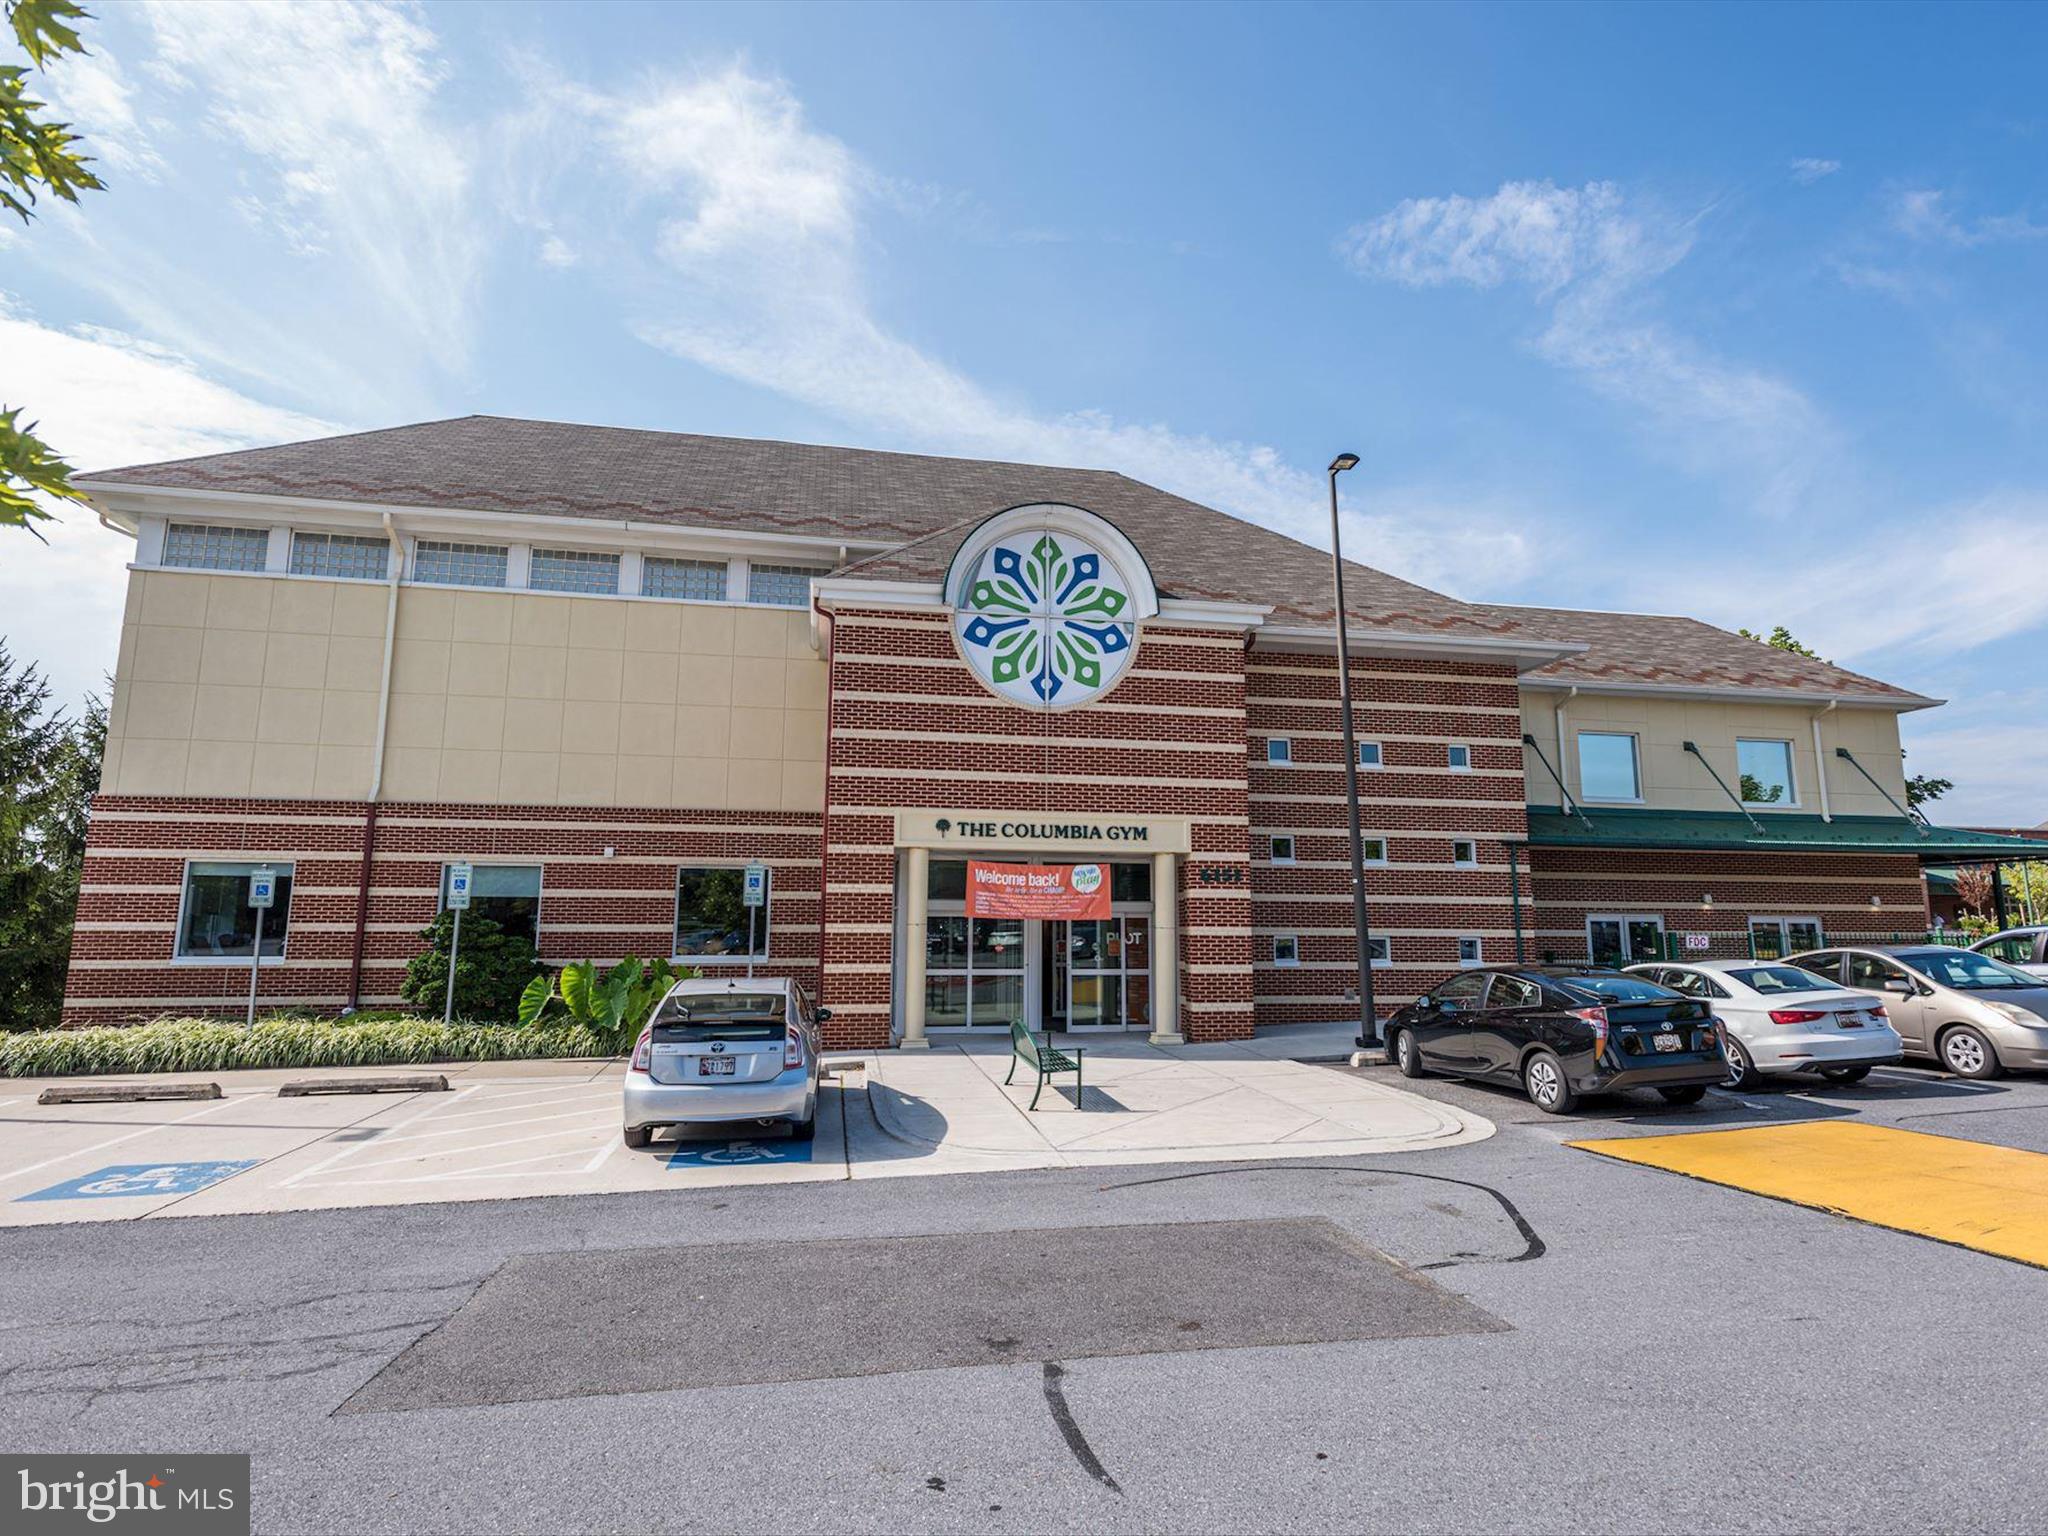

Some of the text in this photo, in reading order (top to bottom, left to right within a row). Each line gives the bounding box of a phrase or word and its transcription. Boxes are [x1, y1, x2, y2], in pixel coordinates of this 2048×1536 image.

[957, 821, 1148, 841] THE COLUMBIA GYM
[975, 868, 1060, 887] Welcome back!
[1106, 932, 1143, 945] PIOT
[1688, 937, 1706, 947] FDC
